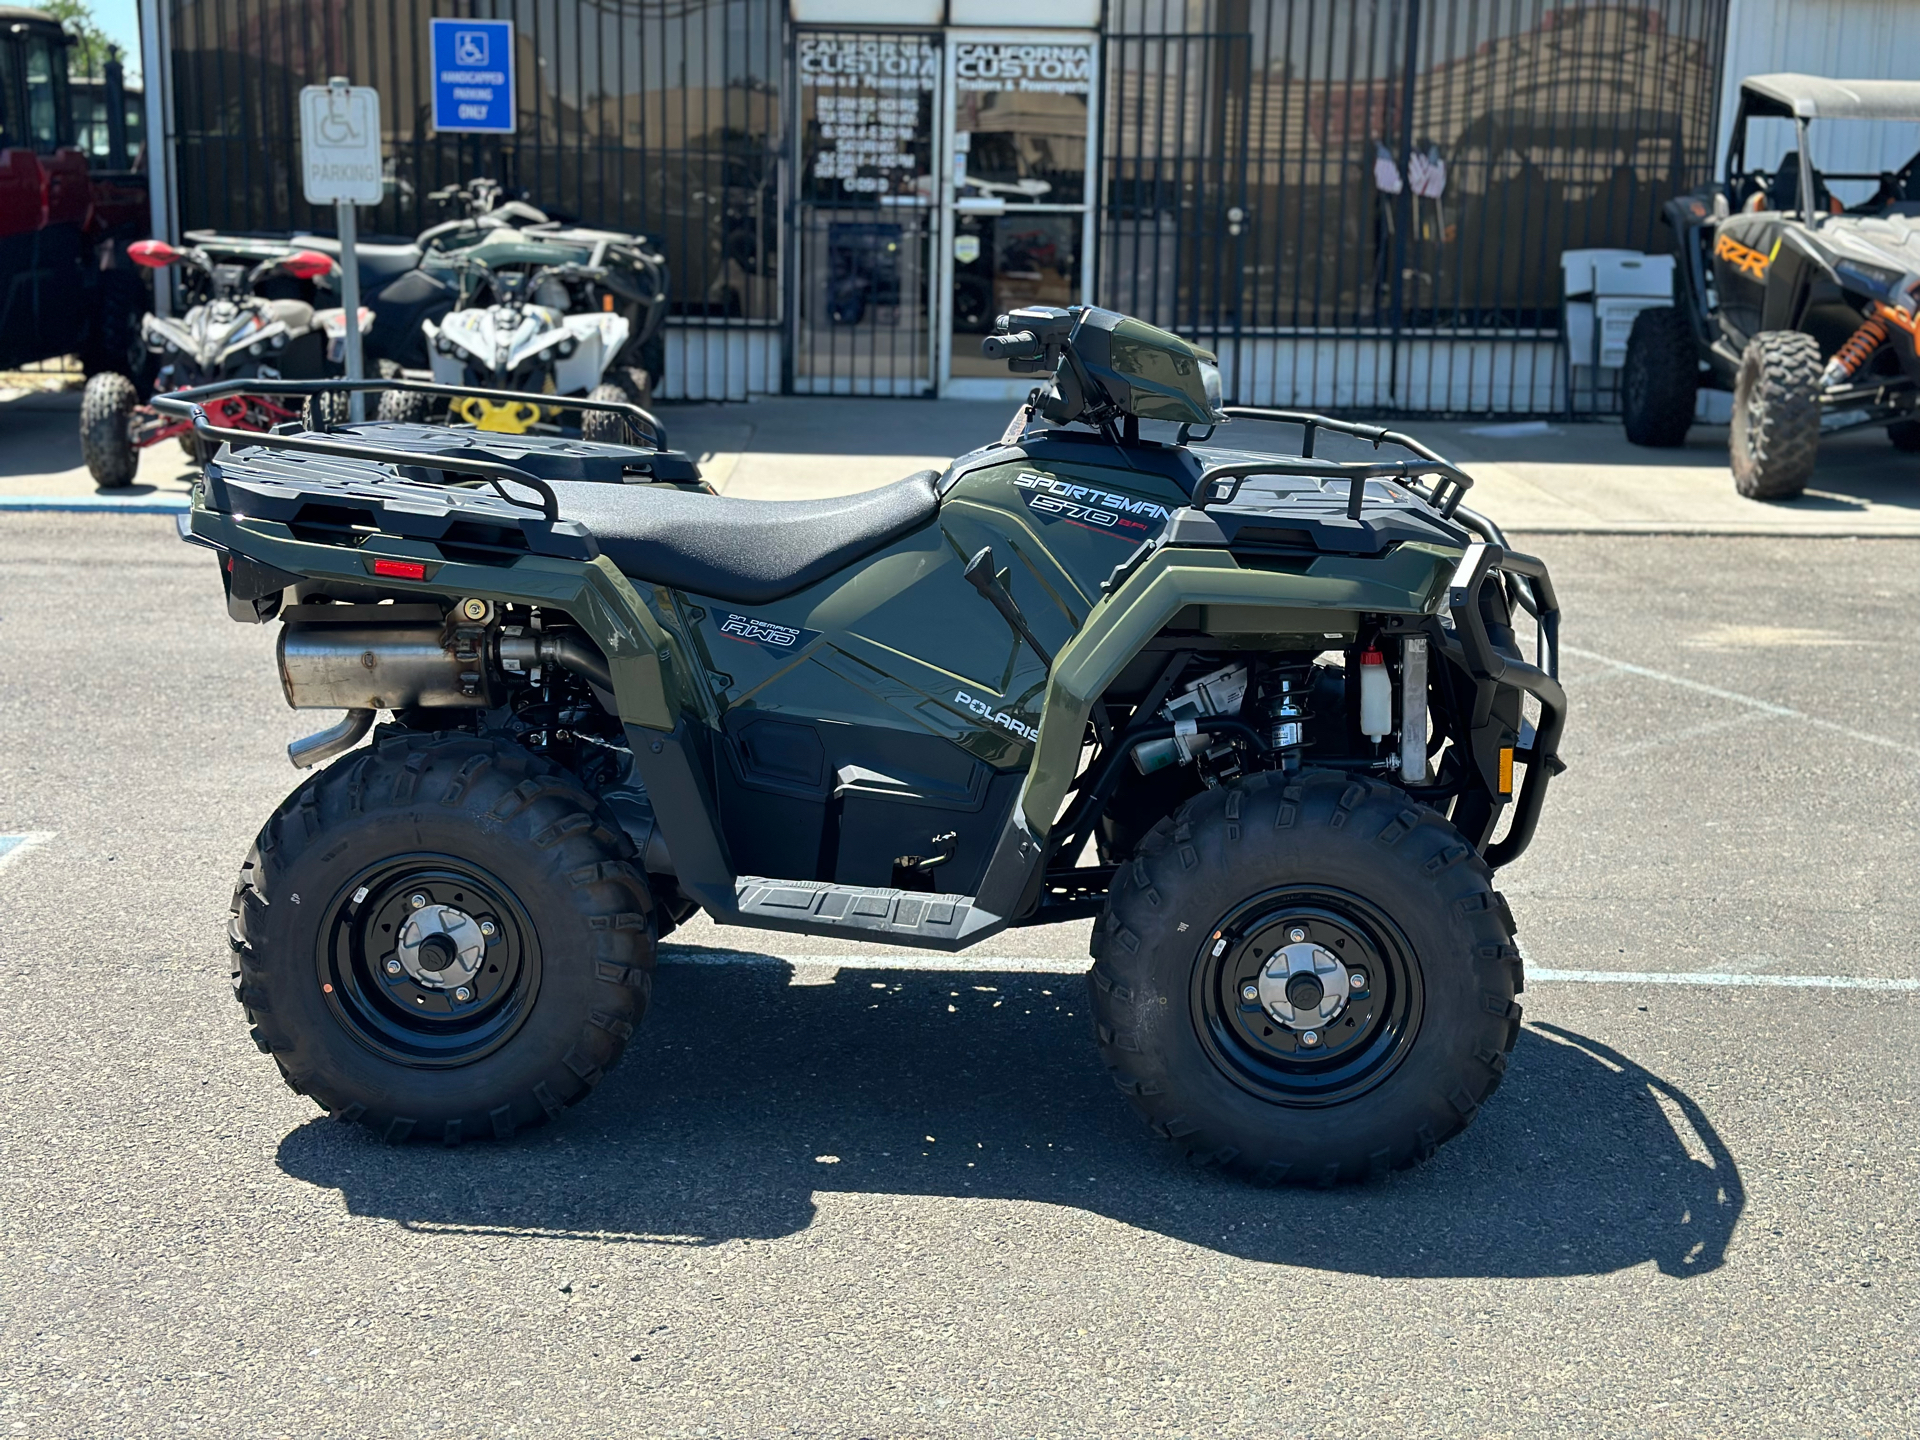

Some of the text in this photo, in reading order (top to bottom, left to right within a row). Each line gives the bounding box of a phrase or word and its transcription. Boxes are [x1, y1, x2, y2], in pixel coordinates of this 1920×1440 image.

[958, 45, 1088, 60] CALIFORNIA
[802, 54, 936, 74] CUSTOM
[957, 59, 1089, 79] CUSTOM
[453, 87, 493, 101] PARKING
[458, 104, 489, 120] ONLY
[312, 164, 374, 182] PARKING
[1715, 234, 1769, 279] RZR
[1013, 472, 1170, 522] SPORTSMAN
[1029, 494, 1119, 528] 570
[721, 619, 796, 646] AWD
[728, 613, 800, 635] ON DEMAND
[955, 691, 1039, 743] POLARIS
